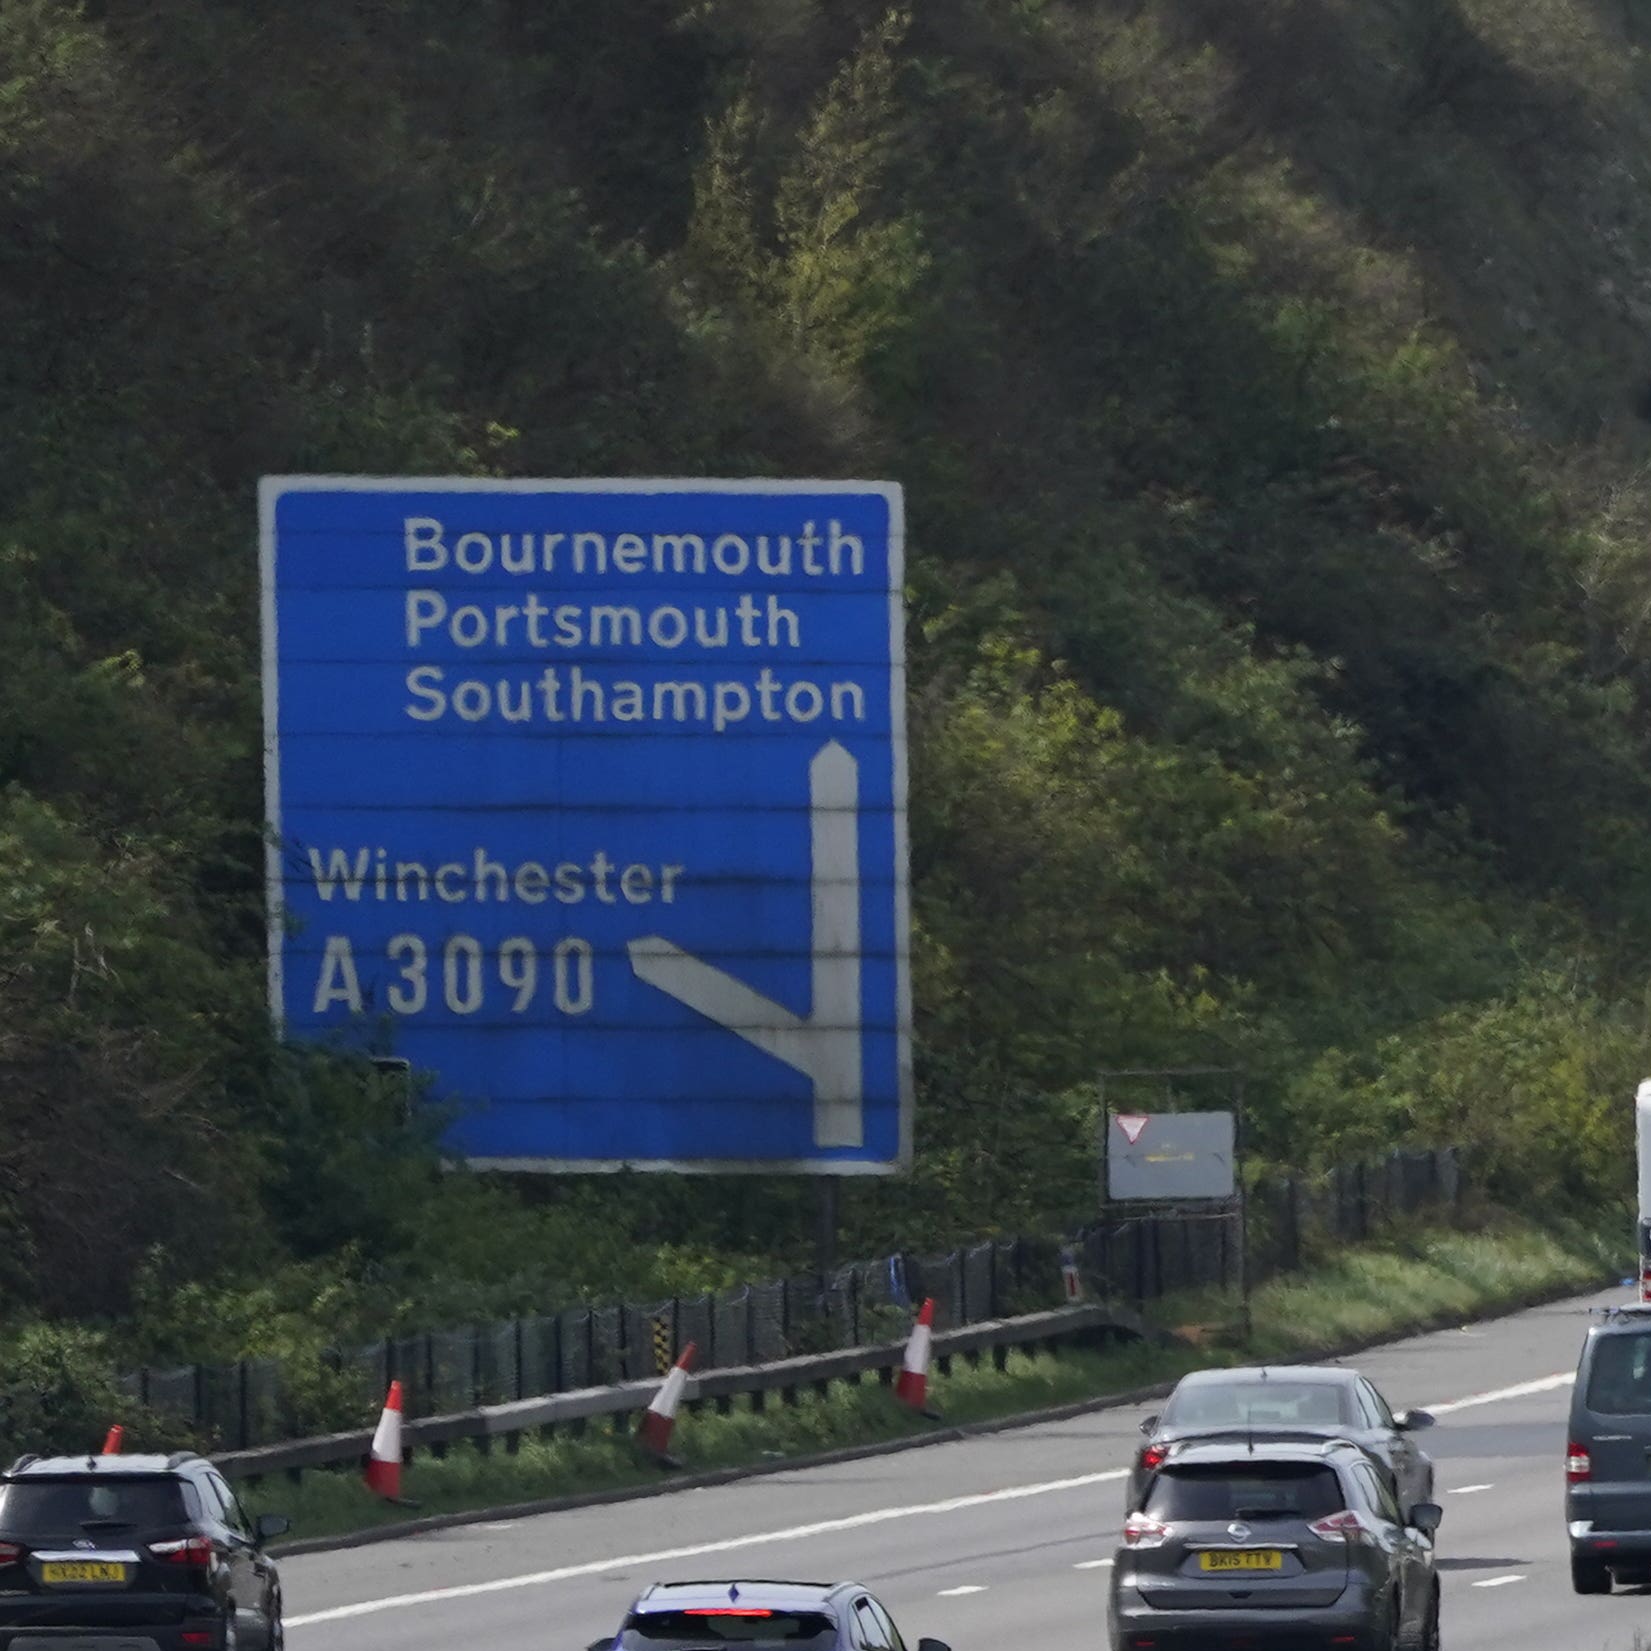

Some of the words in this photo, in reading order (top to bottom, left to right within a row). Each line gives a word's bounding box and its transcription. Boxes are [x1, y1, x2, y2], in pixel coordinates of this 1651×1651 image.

[403, 517, 865, 576] Bournemouth
[404, 589, 801, 648] Portsmouth
[404, 665, 866, 733] Southampton
[308, 848, 685, 904] Winchester
